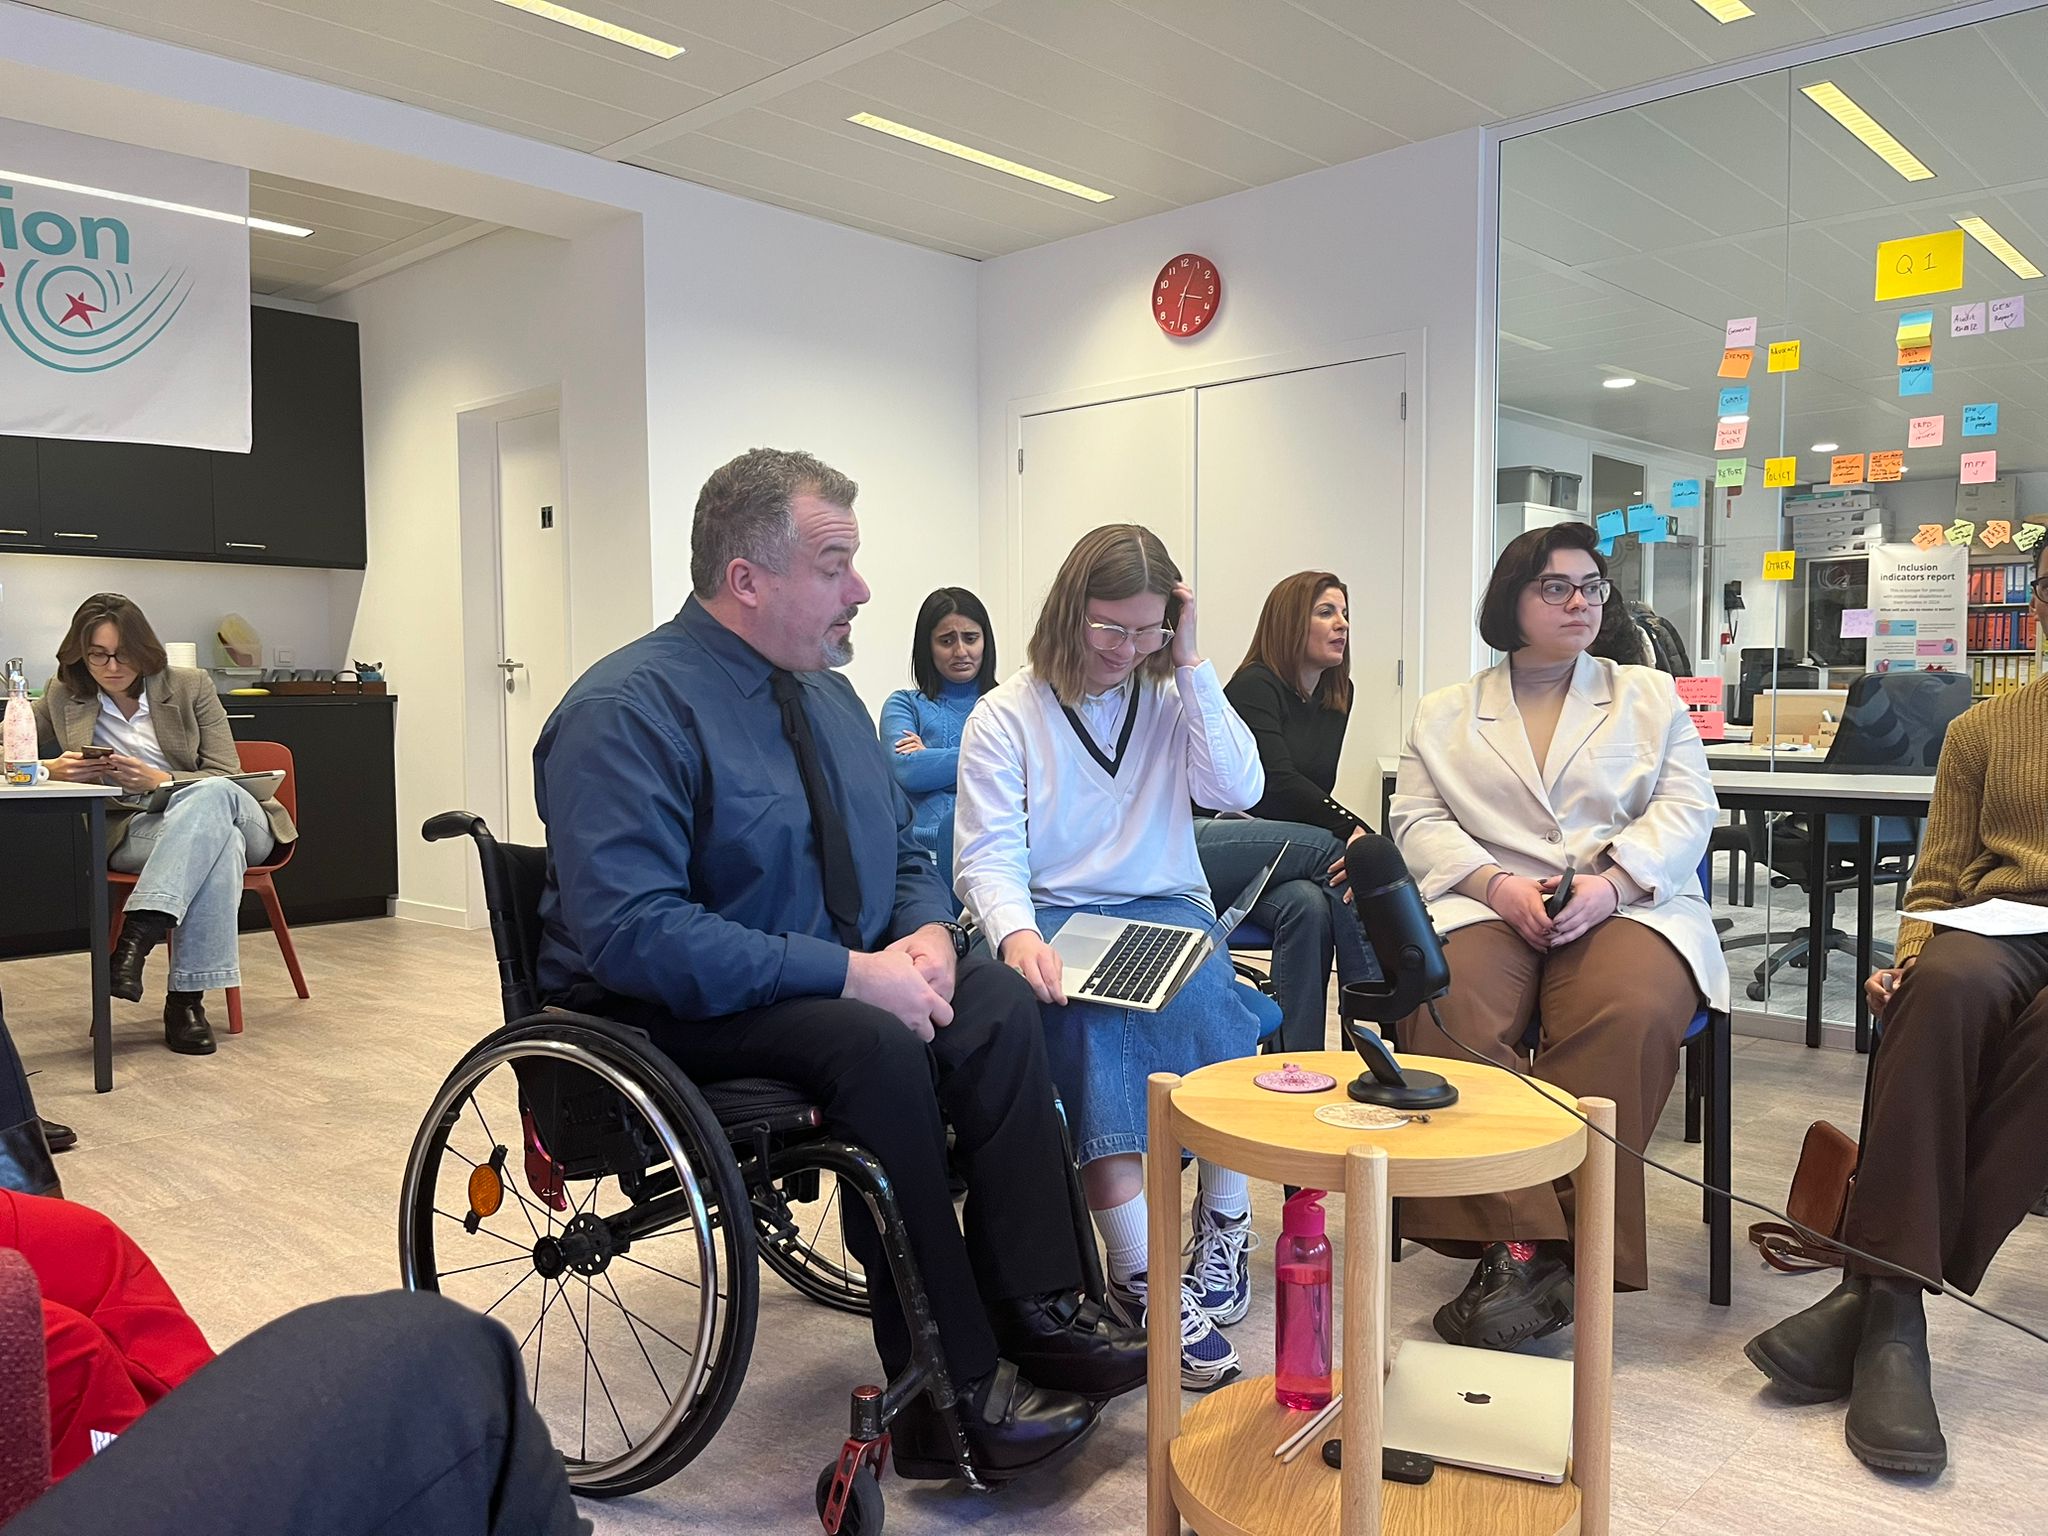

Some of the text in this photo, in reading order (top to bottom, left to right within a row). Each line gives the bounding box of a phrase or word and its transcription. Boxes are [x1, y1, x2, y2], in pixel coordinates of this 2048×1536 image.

[1181, 258, 1189, 267] 12
[1896, 252, 1938, 275] Q 1
[1169, 267, 1176, 275] 11
[1204, 270, 1211, 279] 2
[1160, 280, 1169, 289] 10
[1208, 285, 1214, 294] 3
[1157, 296, 1163, 305] 9
[1160, 312, 1166, 320] 8
[1195, 315, 1201, 325] 5
[1169, 321, 1175, 330] 7
[1182, 323, 1188, 332] 6
[1718, 468, 1742, 478] REPORT
[1766, 468, 1791, 481] POLICY
[1765, 559, 1792, 571] OTHER
[1897, 563, 1938, 572] Inclusion
[1880, 573, 1955, 582] indicators report
